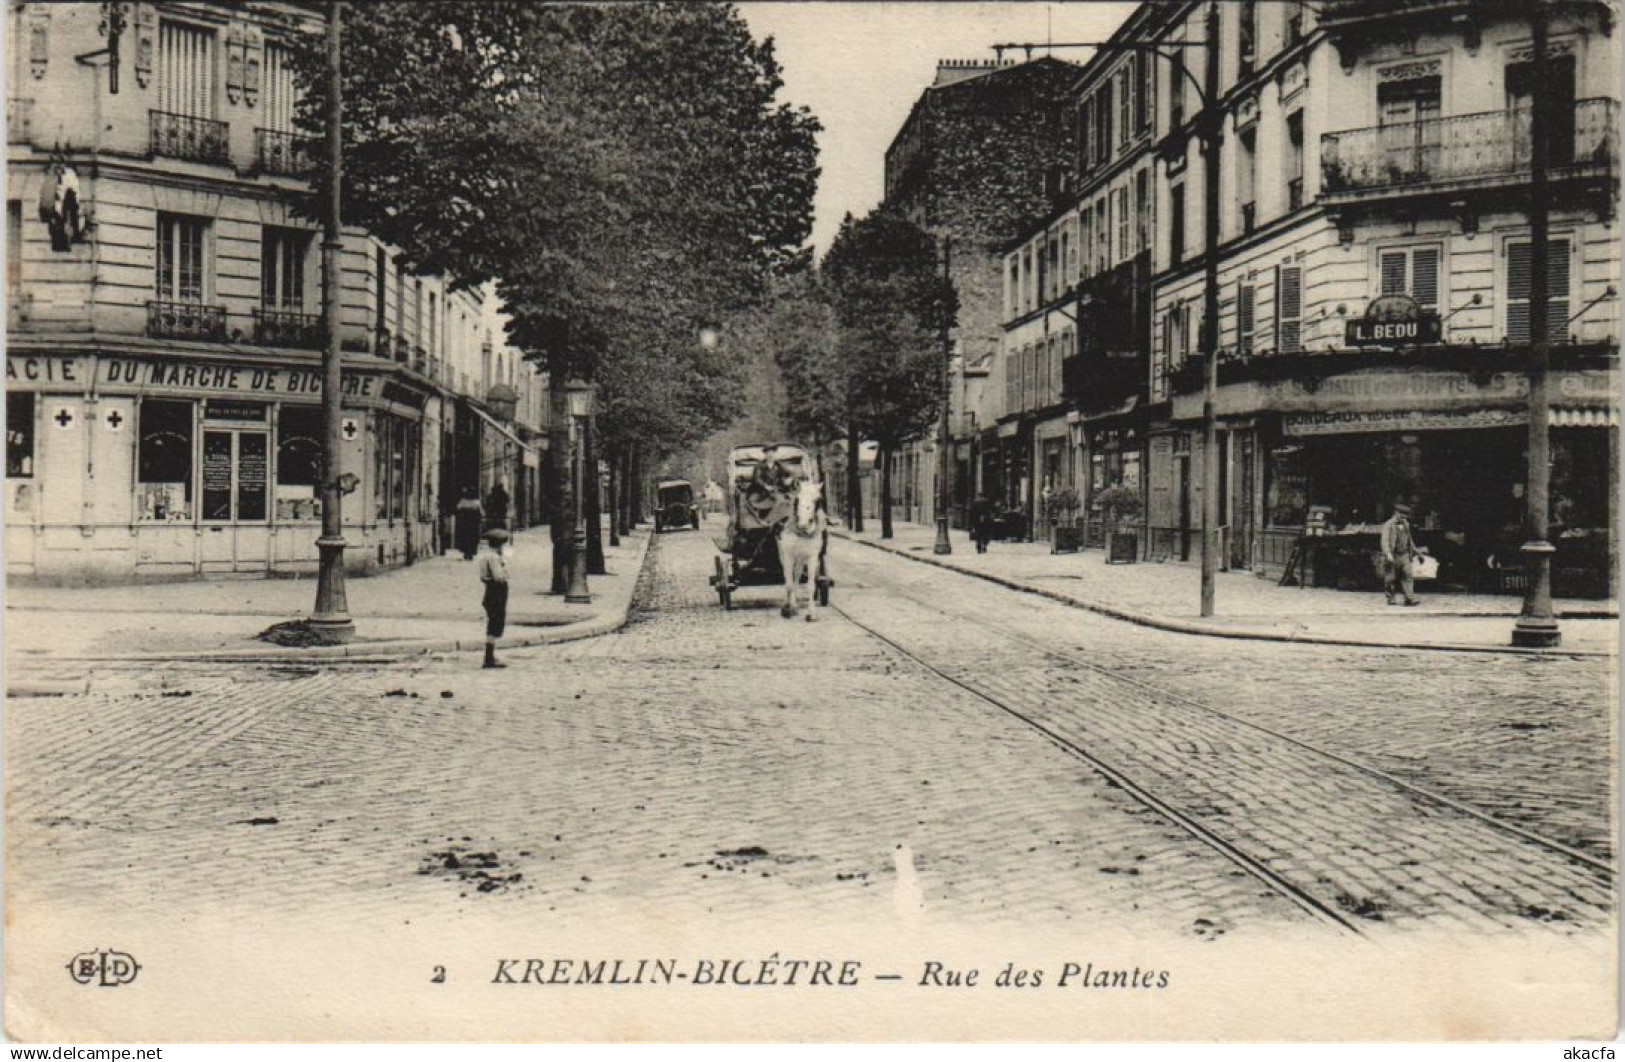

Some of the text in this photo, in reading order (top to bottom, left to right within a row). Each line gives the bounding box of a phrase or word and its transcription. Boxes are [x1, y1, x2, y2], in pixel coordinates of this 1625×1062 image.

[1374, 322, 1418, 340] BEDU
[107, 360, 139, 383] DU
[150, 362, 241, 390] MARCHE
[251, 368, 279, 390] DE
[287, 370, 374, 397] BICTRE
